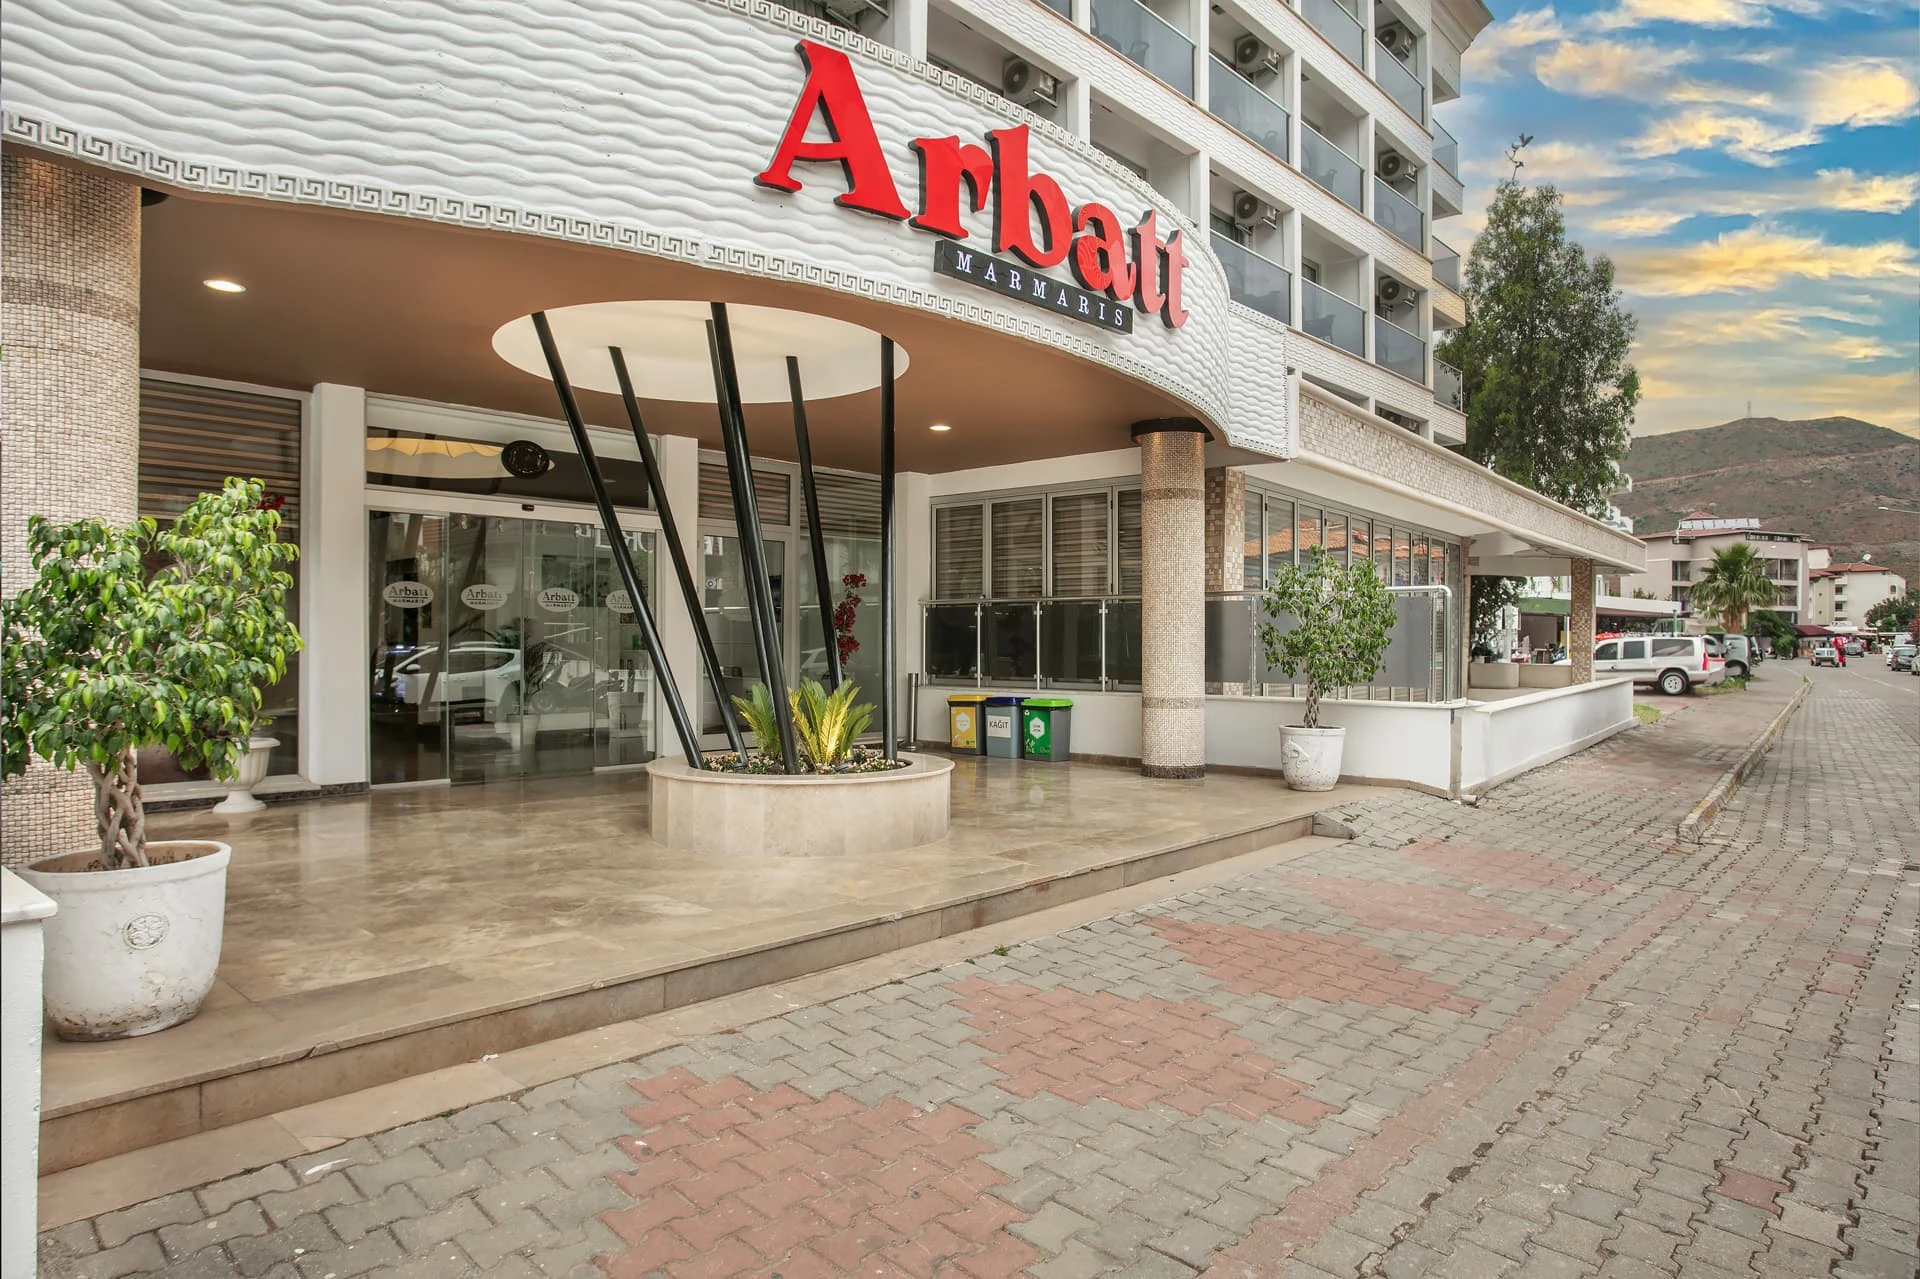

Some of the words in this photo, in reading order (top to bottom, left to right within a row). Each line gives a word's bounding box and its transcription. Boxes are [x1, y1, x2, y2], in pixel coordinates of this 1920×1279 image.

[754, 39, 1189, 328] Arbatt
[956, 250, 1123, 326] MARMARIS
[989, 719, 1009, 729] KAĞIT
